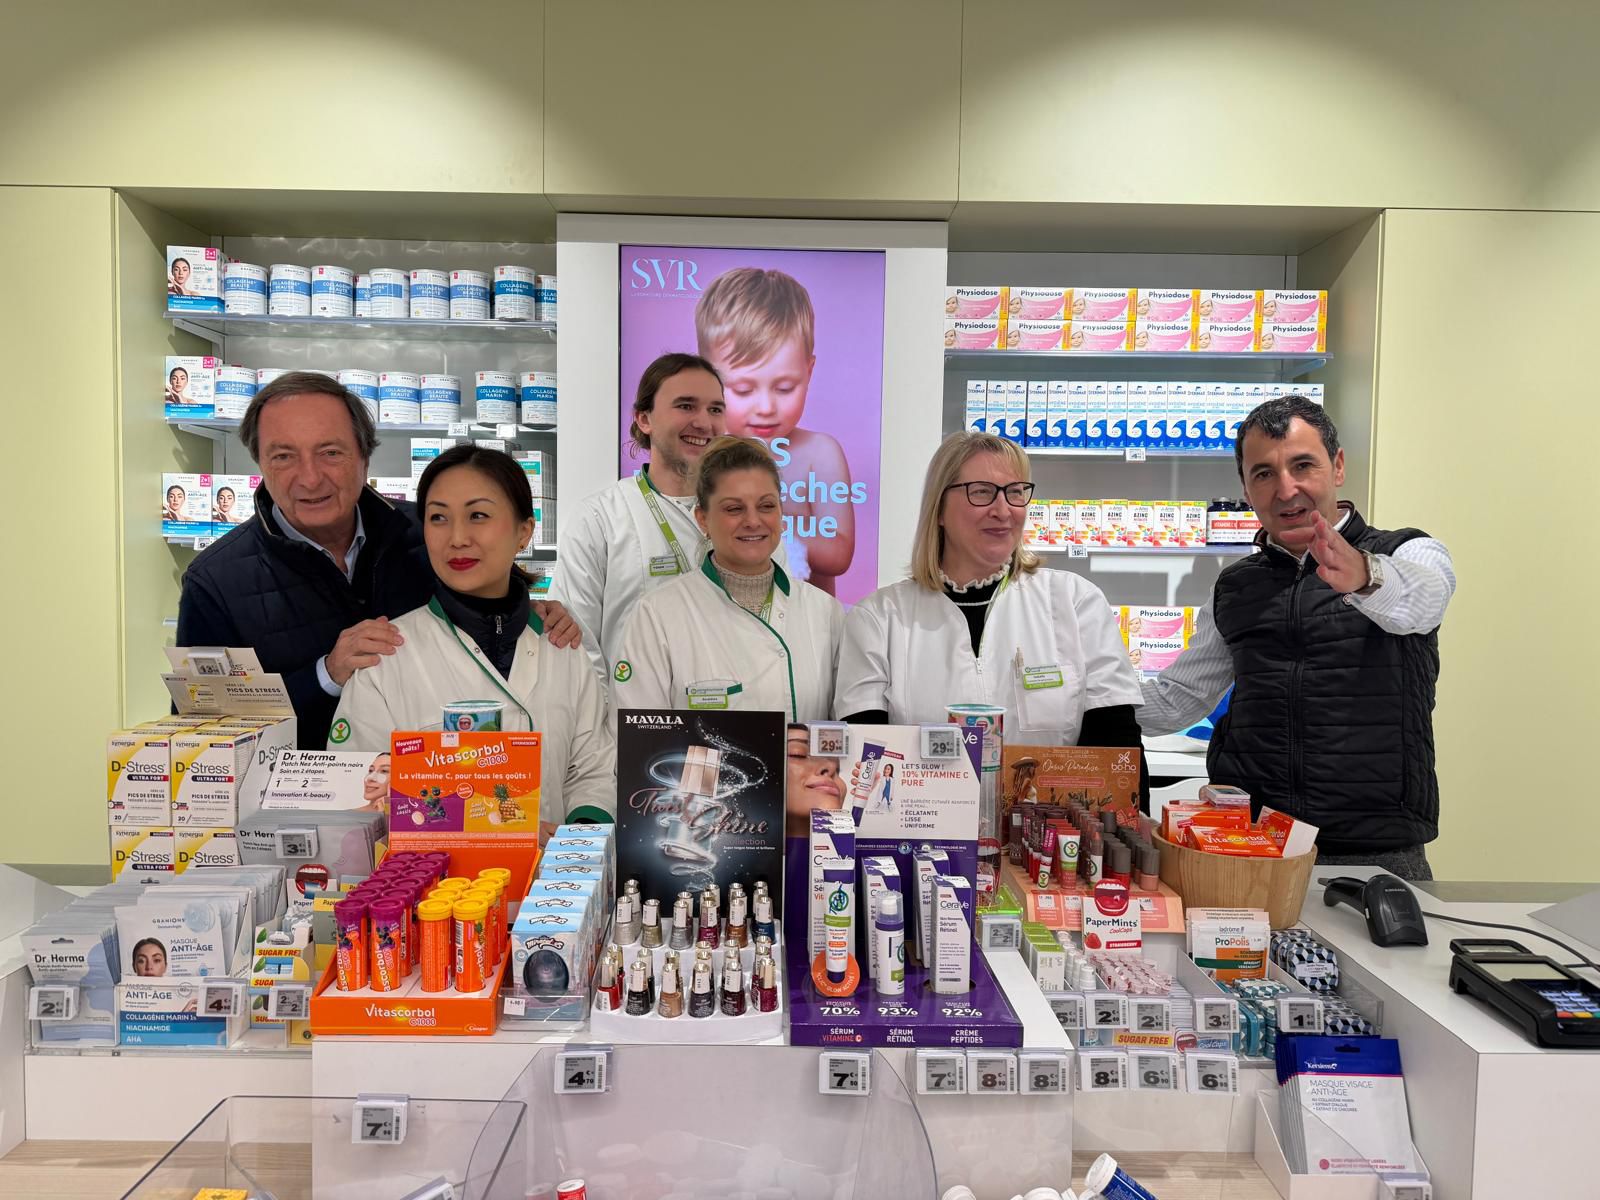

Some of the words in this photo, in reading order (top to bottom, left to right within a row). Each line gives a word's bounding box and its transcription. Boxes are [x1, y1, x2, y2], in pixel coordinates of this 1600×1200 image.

[631, 258, 703, 290] SVR
[956, 288, 998, 296] Physiodose
[1020, 289, 1062, 297] Physiodose
[1275, 292, 1317, 300] Physiodose
[954, 322, 996, 330] Physiodose
[1273, 325, 1316, 333] Physiodose
[625, 715, 684, 724] MAVALA
[822, 740, 835, 751] 29
[932, 743, 947, 754] 29
[300, 752, 336, 761] Herma
[424, 741, 506, 768] Vitascorbol
[112, 760, 165, 773] D-Stress
[176, 762, 230, 774] D-Stress
[505, 772, 526, 780] goûts
[902, 770, 918, 778] 10%
[920, 770, 961, 778] VITAMINE
[276, 780, 281, 788] 1
[301, 780, 308, 788] 2
[901, 778, 924, 787] PURE
[288, 844, 299, 854] 3
[116, 850, 170, 863] D-Stress
[179, 852, 234, 864] D-Stress
[940, 900, 969, 910] CeraVe
[1086, 917, 1138, 928] PaperMints
[1215, 937, 1250, 946] ProPolis
[170, 944, 214, 952] ANTI-ÂGE
[50, 954, 84, 962] Herma
[125, 990, 172, 1000] ANTI-ÂGE
[41, 1002, 56, 1014] 2
[208, 999, 224, 1012] 4
[366, 1004, 435, 1018] Vitascorbol
[820, 1006, 860, 1016] 70%
[878, 1007, 918, 1016] 93%
[942, 1008, 982, 1017] 92%
[1098, 1010, 1112, 1022] 2
[126, 1013, 166, 1021] COLLAGÈNE
[1141, 1016, 1155, 1028] 2
[1208, 1015, 1222, 1027] 3
[1294, 1014, 1304, 1026] 1
[830, 1027, 854, 1035] SÉRUM
[890, 1028, 913, 1036] SÉRUM
[955, 1028, 979, 1037] CRÈME
[886, 1034, 916, 1043] RÉTINOL
[950, 1036, 984, 1044] PEPTIDES
[1118, 1034, 1146, 1044] SUGAR
[1148, 1036, 1170, 1044] FREE
[568, 1072, 586, 1086] 4
[833, 1073, 849, 1087] 7
[930, 1074, 946, 1087] 7
[982, 1074, 997, 1087] 8
[1034, 1074, 1049, 1088] 8
[1094, 1071, 1110, 1085] 8
[1143, 1070, 1160, 1084] 6
[1202, 1073, 1218, 1088] 6
[1310, 1080, 1345, 1088] MASQUE
[1346, 1080, 1374, 1088] VISAGE
[1311, 1088, 1348, 1096] ANTI-ÂGE
[366, 1122, 384, 1136] 7
